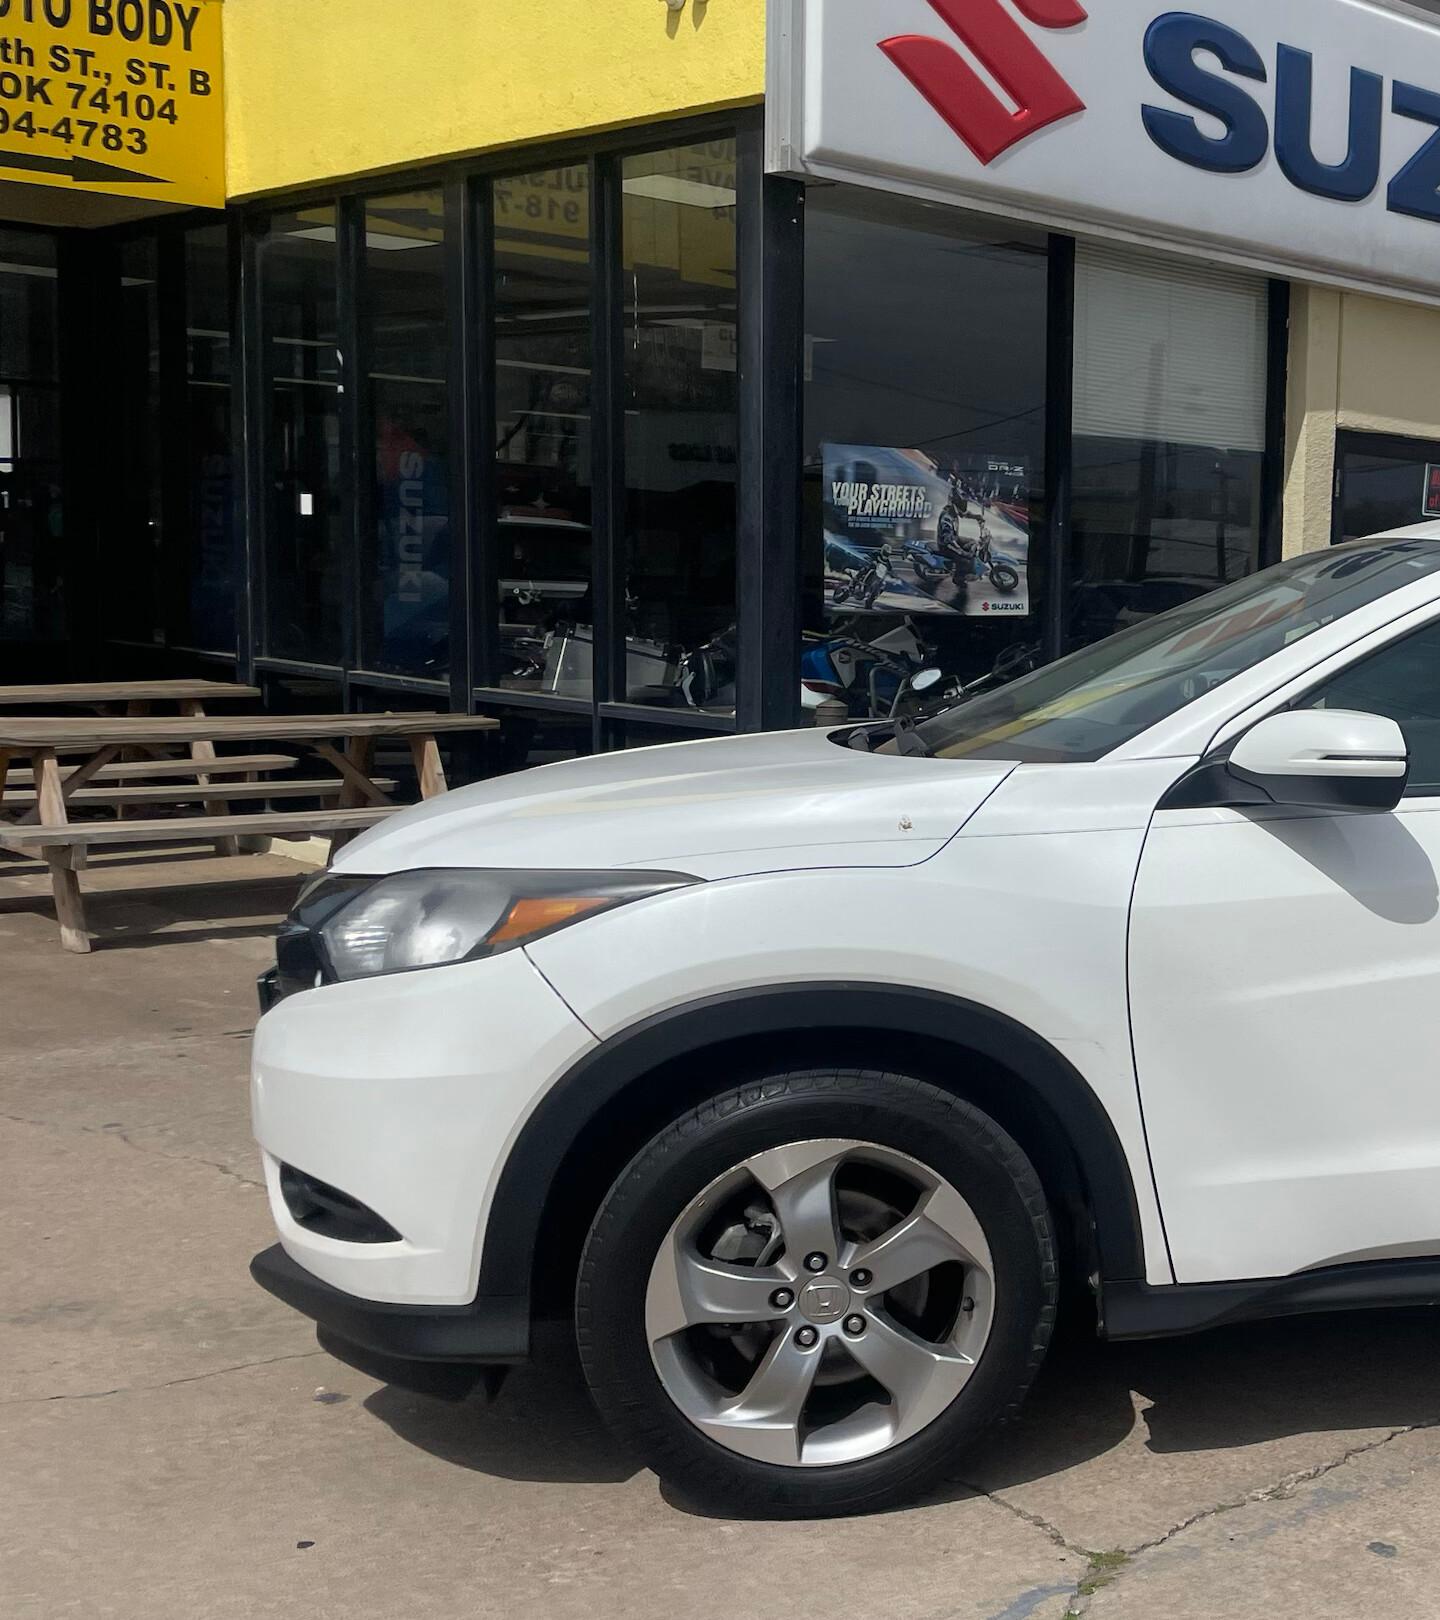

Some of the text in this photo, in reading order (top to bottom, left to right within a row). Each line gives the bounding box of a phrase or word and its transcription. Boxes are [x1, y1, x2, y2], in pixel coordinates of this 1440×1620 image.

[0, 0, 200, 51] TO BODY
[48, 45, 112, 86] ST.,
[126, 58, 176, 91] ST.
[190, 69, 212, 97] B
[0, 72, 179, 124] OK 74104
[832, 481, 927, 502] YOUR STREETS
[848, 498, 933, 519] PLAYGROUND
[399, 451, 424, 602] SUZUKI
[991, 603, 1025, 611] SUZUKI
